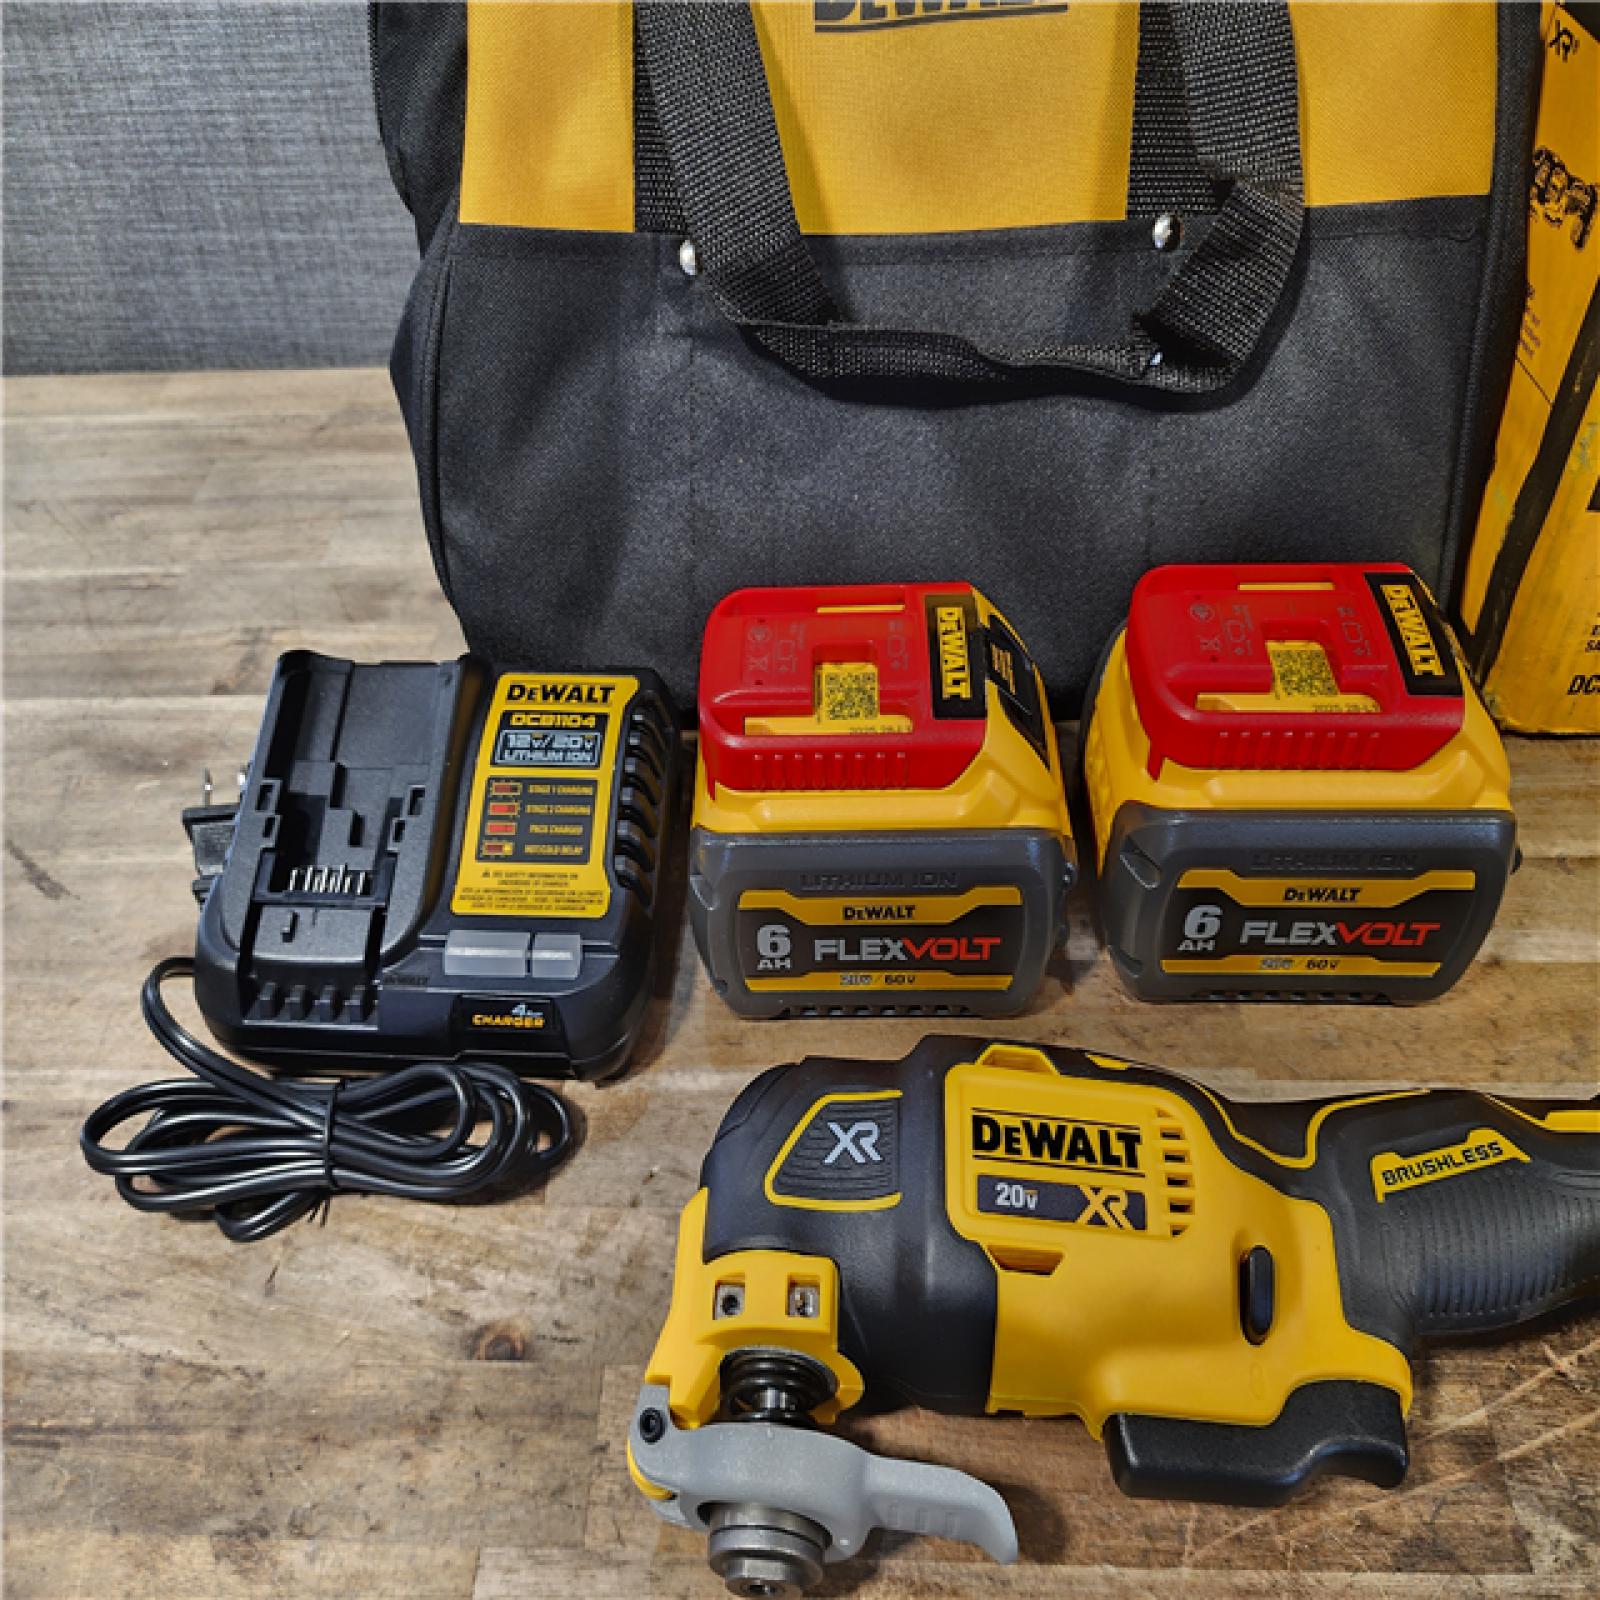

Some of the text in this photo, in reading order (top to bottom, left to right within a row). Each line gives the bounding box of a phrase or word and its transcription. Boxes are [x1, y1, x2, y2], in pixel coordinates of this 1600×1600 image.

[756, 924, 792, 959] 6
[1183, 904, 1223, 939] 6
[1239, 921, 1441, 946] FLEXVOLT
[813, 937, 1002, 962] FLEXVOLT
[824, 1120, 884, 1165] XR
[972, 1113, 1142, 1169] DEWALT
[1381, 1140, 1504, 1186] BRUSHLESS
[1074, 1184, 1138, 1232] XR
